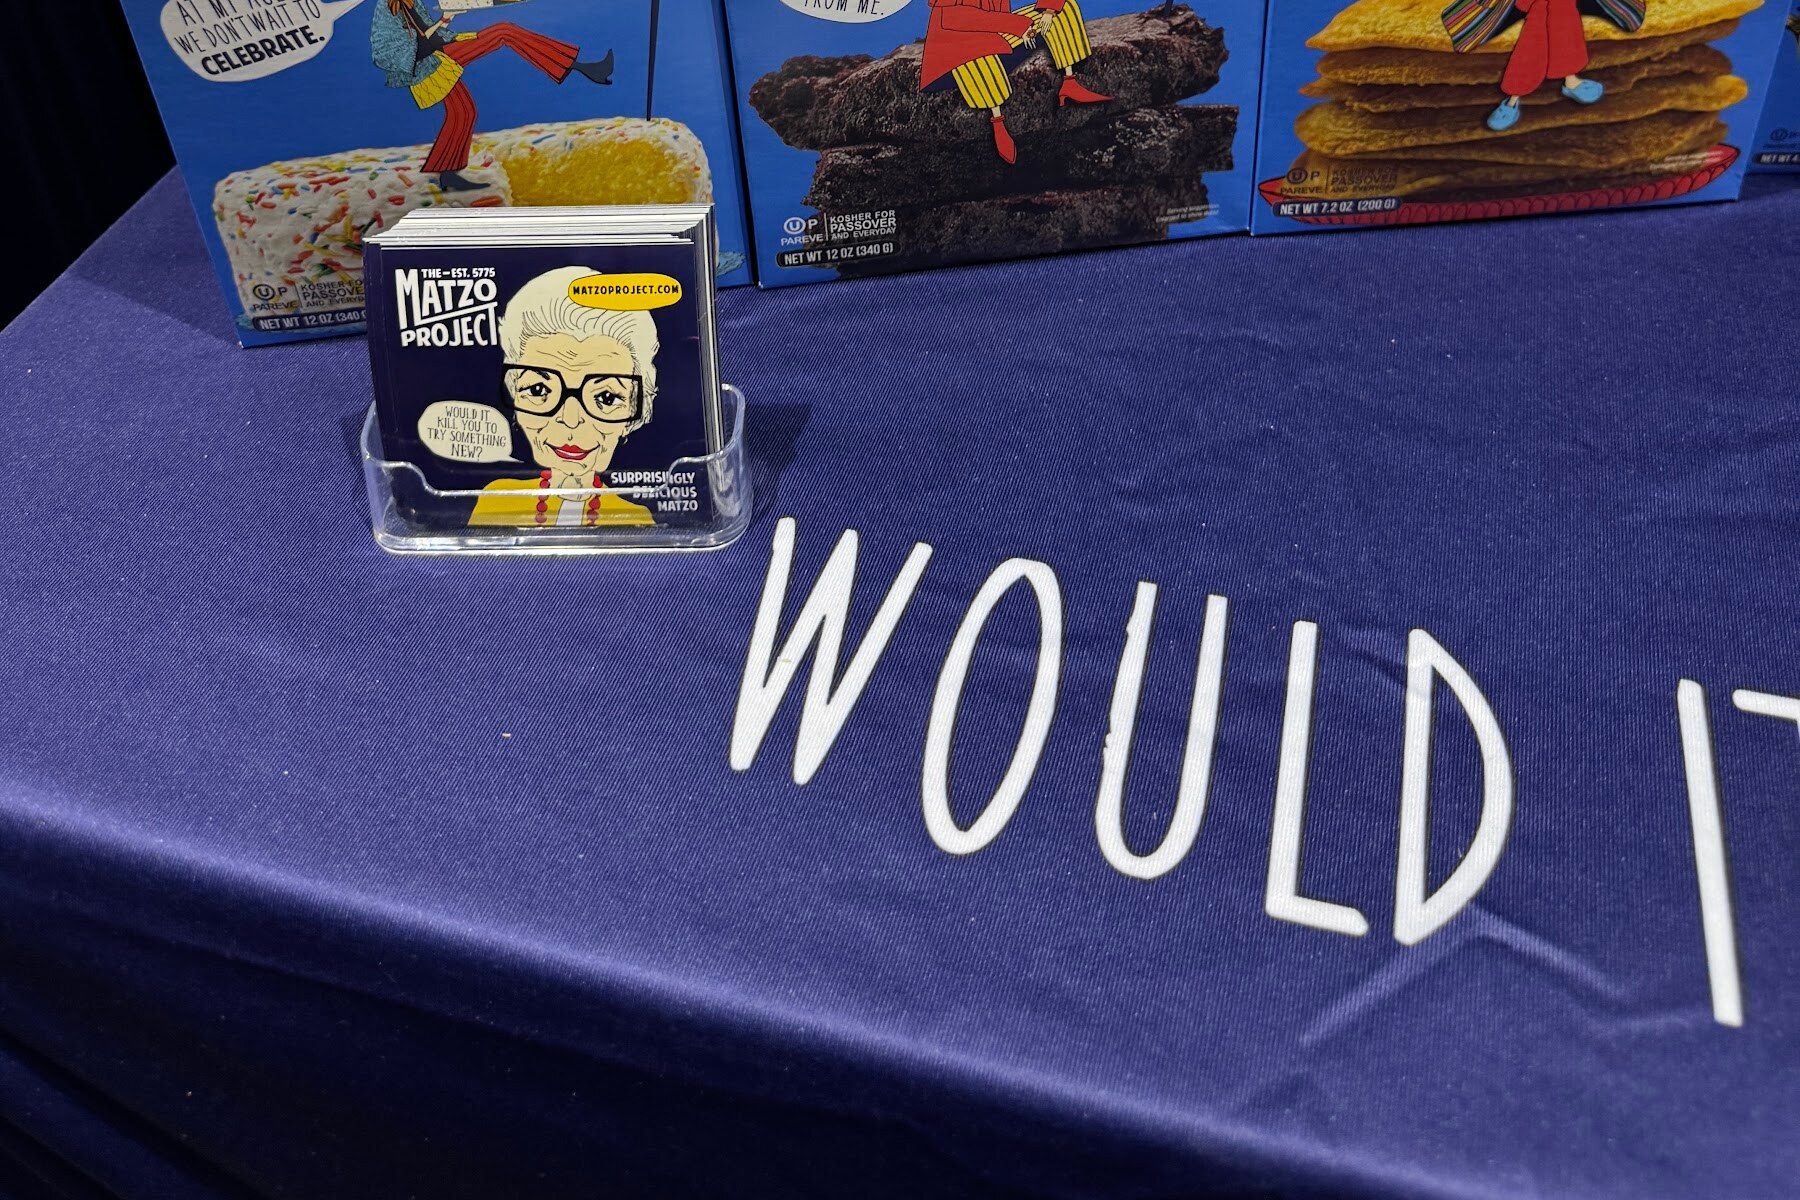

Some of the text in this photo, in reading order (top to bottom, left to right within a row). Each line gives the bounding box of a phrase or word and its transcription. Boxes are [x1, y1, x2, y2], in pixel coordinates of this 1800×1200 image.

[174, 30, 206, 54] WE
[247, 3, 295, 33] WAIT
[201, 24, 325, 76] CELEBRATE.
[1280, 204, 1301, 215] NET
[1303, 203, 1319, 214] WT
[1321, 202, 1337, 213] 7.2
[1340, 201, 1353, 212] OZ
[1357, 200, 1381, 211] (200
[830, 210, 896, 224] KOSHER FOR
[830, 217, 897, 233] PASSOVER
[780, 234, 824, 247] PAREVE
[831, 227, 897, 240] AND EVERYDAY
[784, 242, 894, 265] NET WT 12 OZ (340 G)
[472, 267, 496, 277] 5775
[573, 284, 680, 296] MATZOPROJECT.COM
[252, 301, 299, 312] PAREVE
[395, 269, 497, 330] MATZO
[260, 311, 361, 330] NET WT 12 OZ (340
[400, 303, 498, 348] PROJECT
[445, 406, 491, 421] WOULD IT
[437, 416, 498, 434] KILL YOU TO
[427, 428, 507, 448] TRY SOMETHING
[450, 444, 483, 462] NEW?
[657, 500, 699, 512] MATZO
[729, 516, 1515, 946] WOULD
